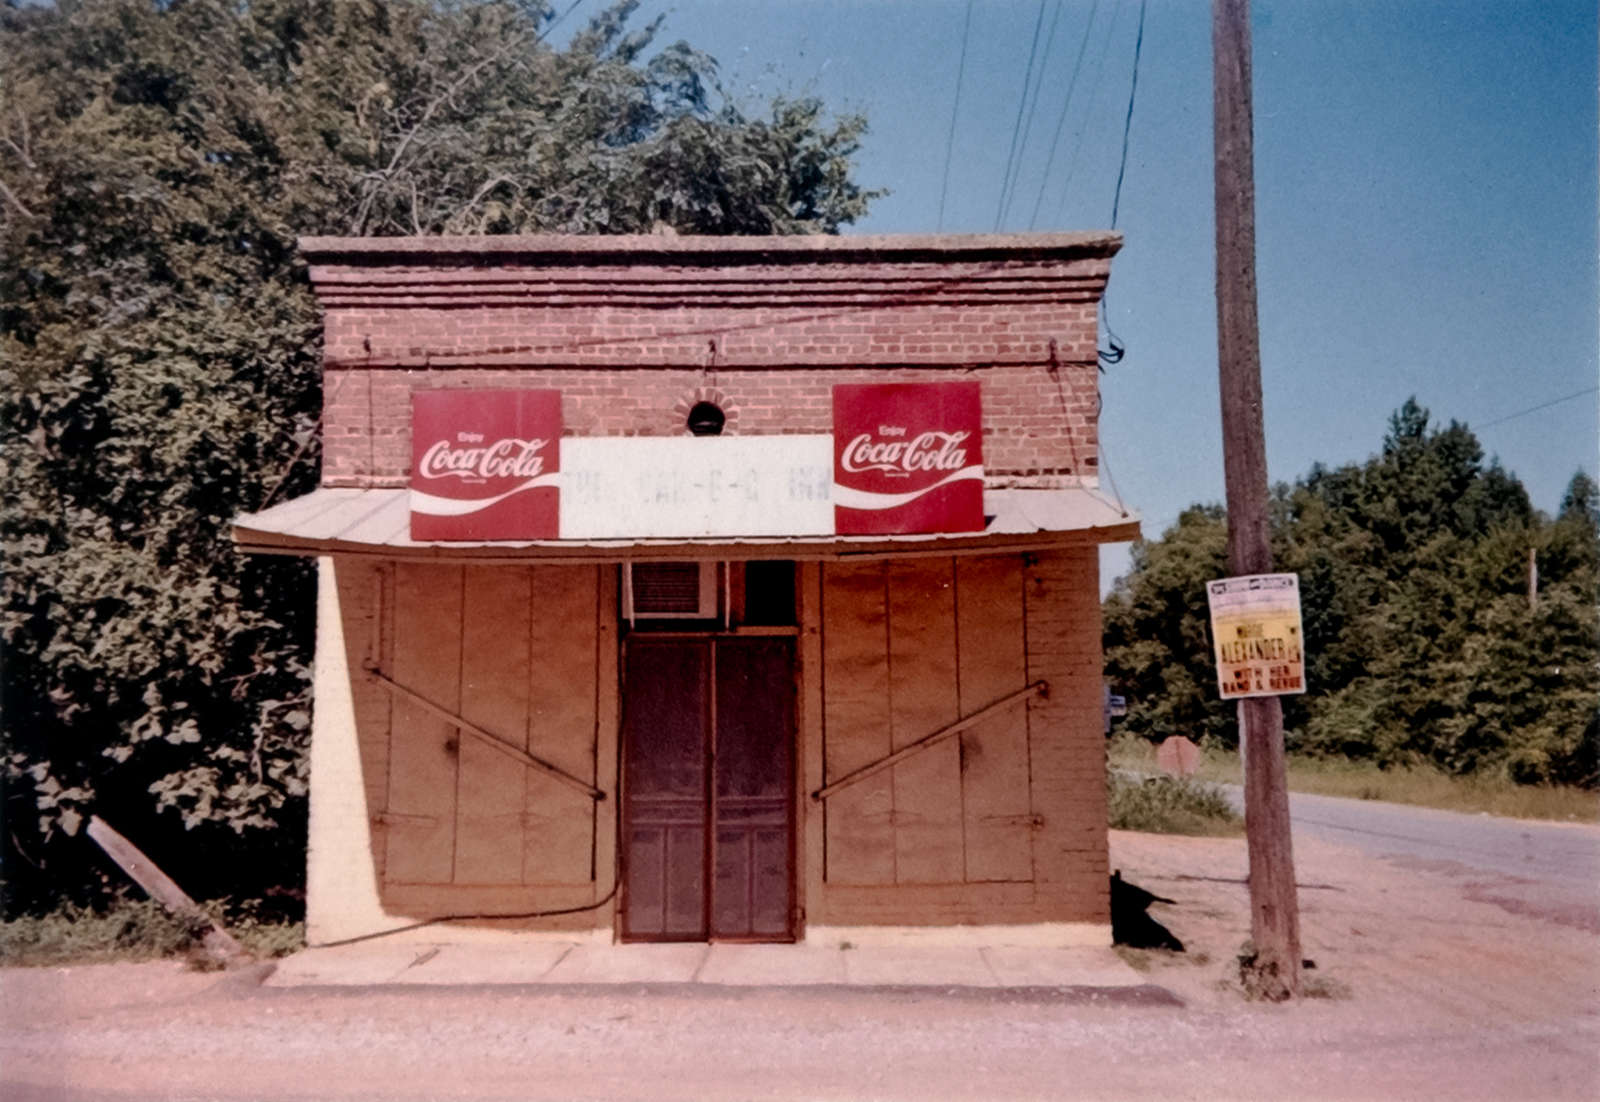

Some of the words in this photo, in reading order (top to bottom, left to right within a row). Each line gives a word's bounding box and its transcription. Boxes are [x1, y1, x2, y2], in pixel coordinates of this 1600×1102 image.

[879, 425, 907, 436] Enjoy
[420, 438, 550, 479] Coca-Cola
[841, 431, 972, 472] Coca-Cola
